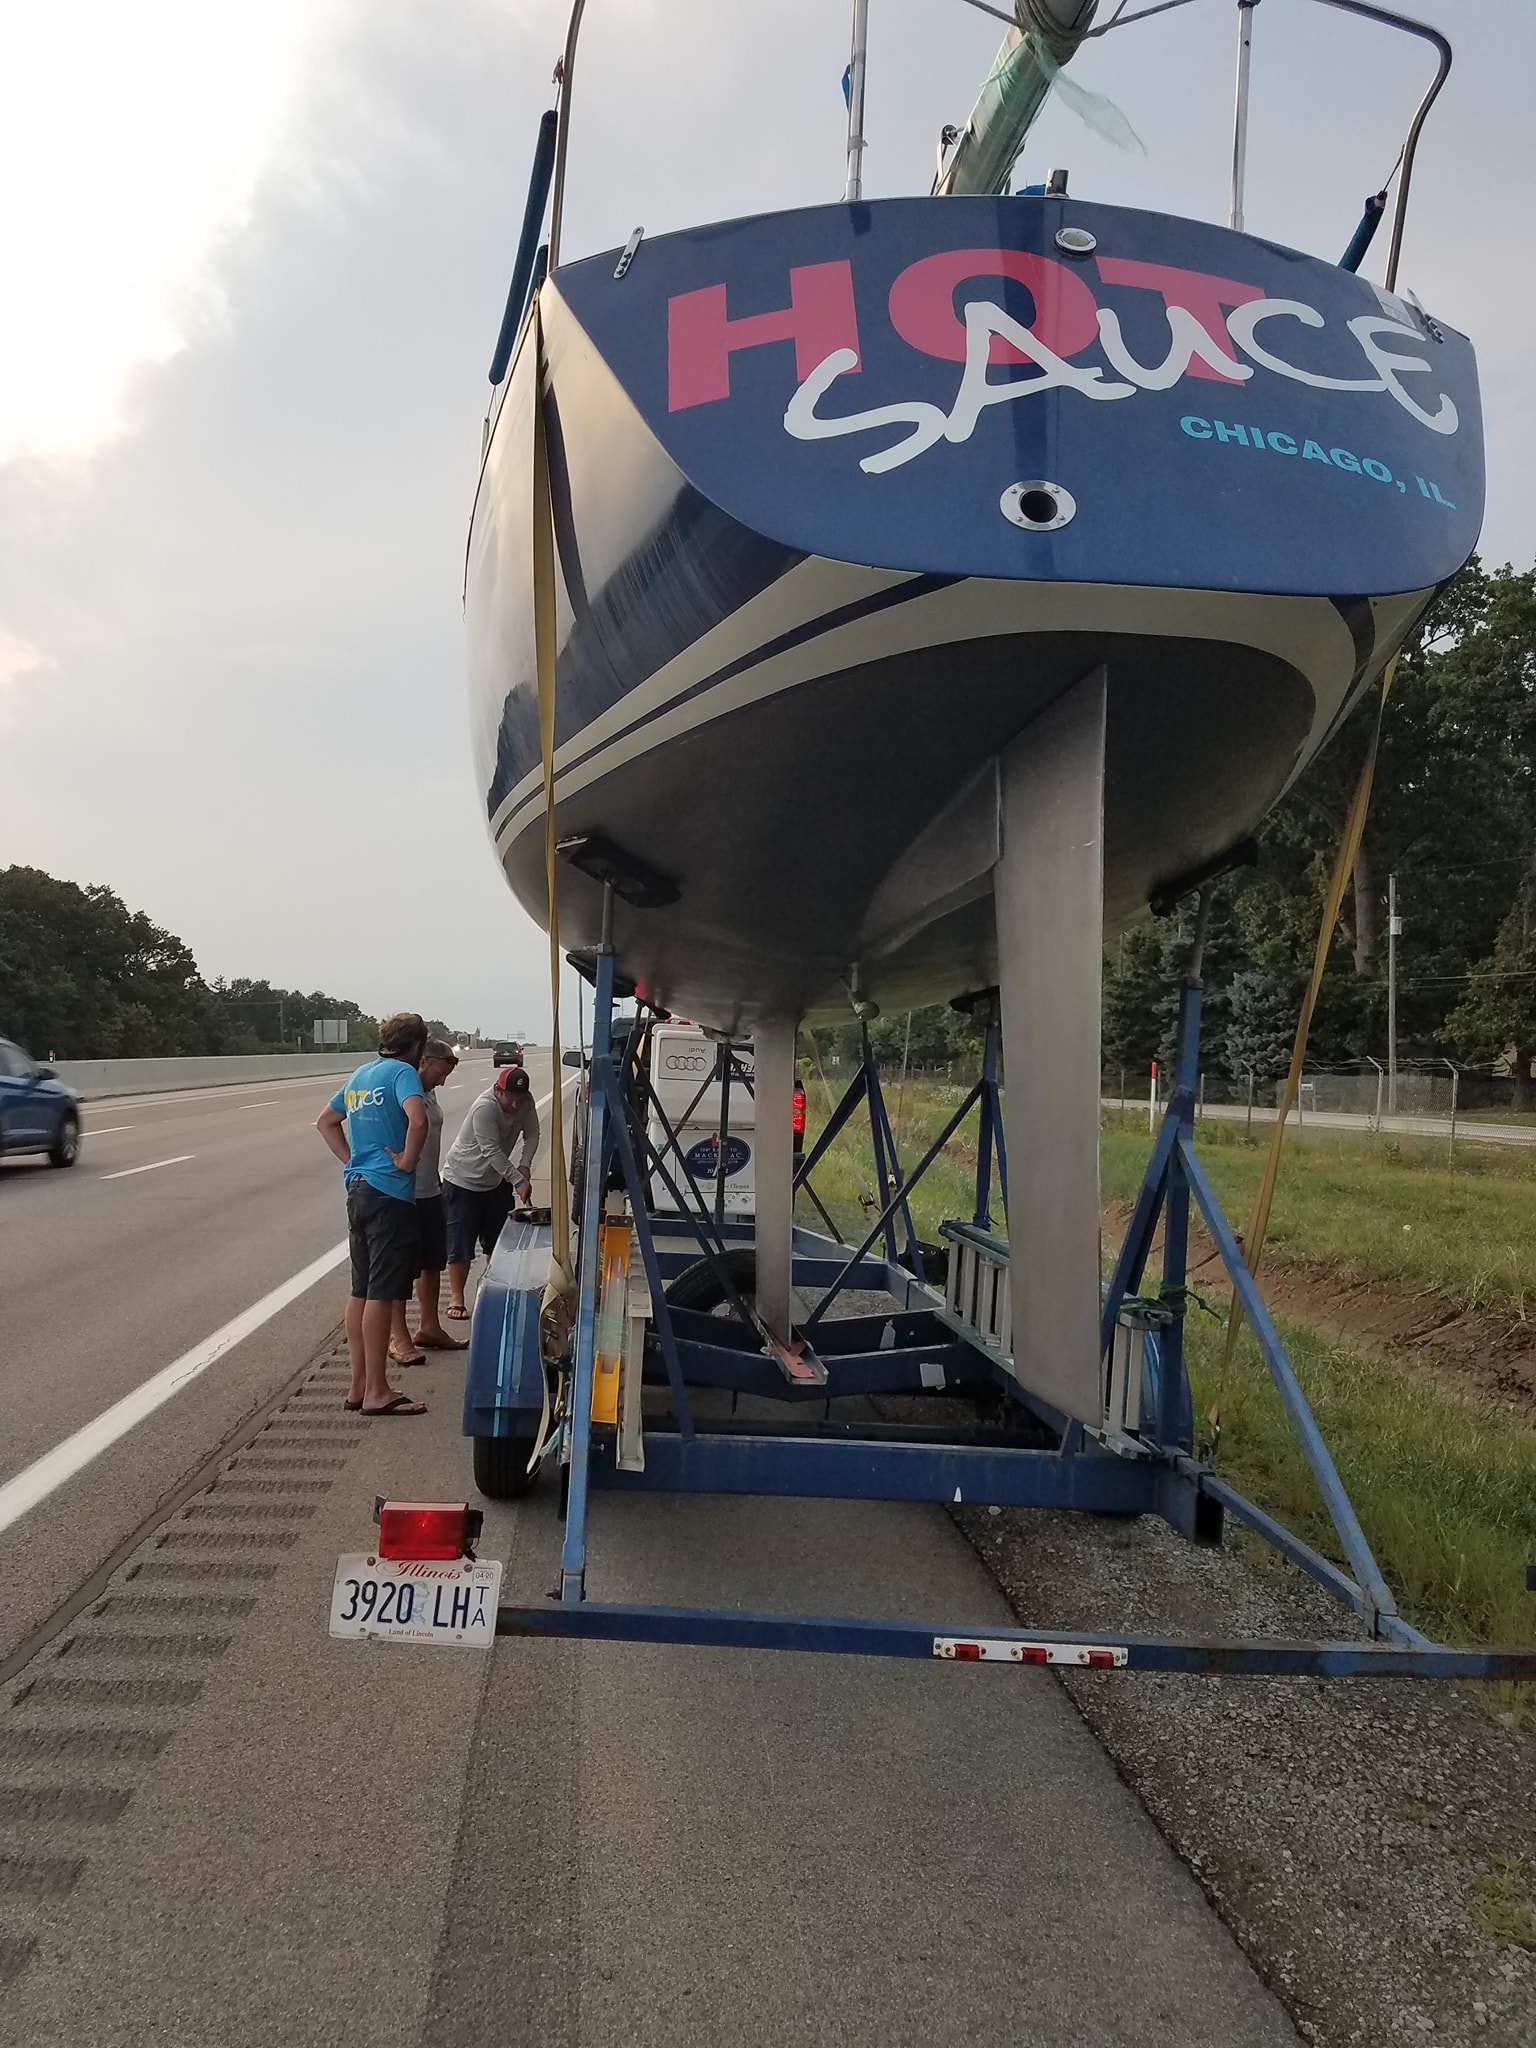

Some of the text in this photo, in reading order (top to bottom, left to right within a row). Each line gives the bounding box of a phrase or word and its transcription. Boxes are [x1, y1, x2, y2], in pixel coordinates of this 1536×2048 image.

[668, 248, 1265, 412] HOT
[784, 298, 1459, 474] SAUCE
[1180, 415, 1457, 510] CHICAGO, IL
[340, 1579, 471, 1629] 3920 LH
[375, 1560, 463, 1581] Illinois
[388, 1628, 404, 1636] Land
[412, 1630, 434, 1638] Lincoln
